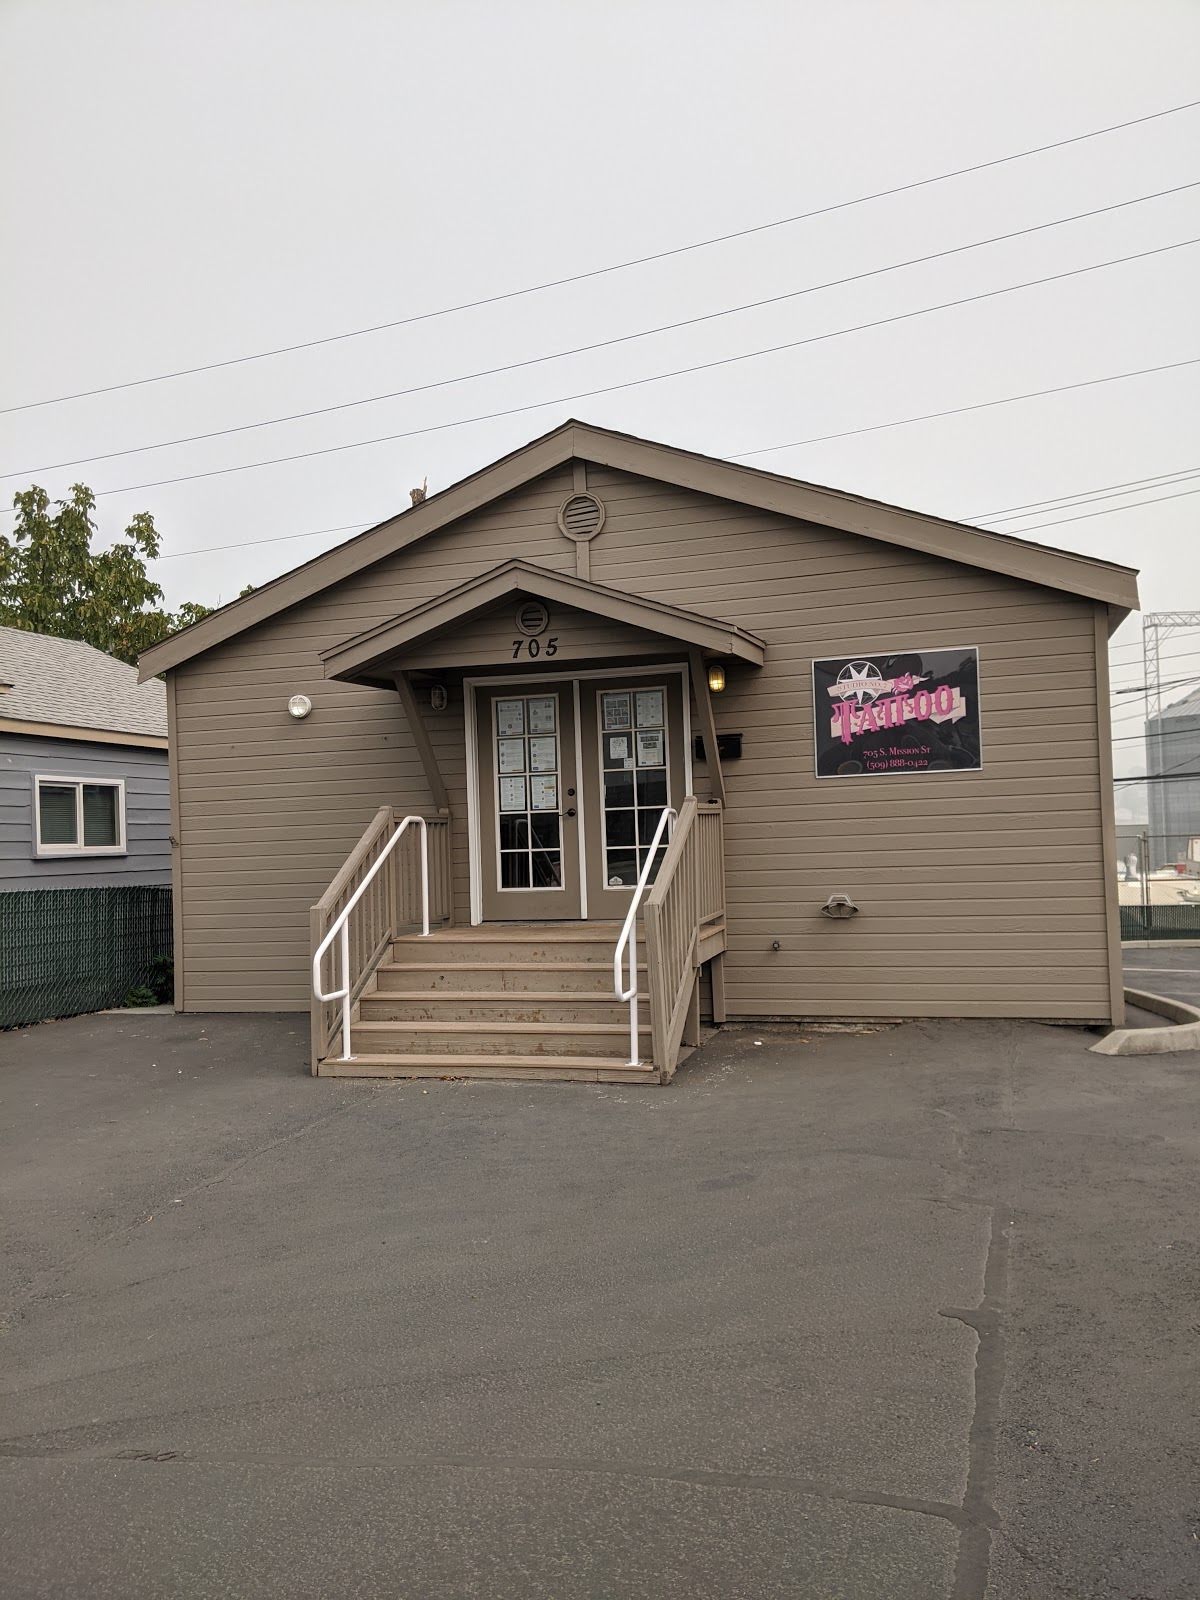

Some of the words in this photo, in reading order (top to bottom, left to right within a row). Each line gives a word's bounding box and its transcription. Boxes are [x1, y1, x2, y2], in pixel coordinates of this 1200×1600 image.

[513, 637, 559, 659] 705
[837, 681, 867, 691] STUDIO
[831, 685, 955, 746] TATTOO
[863, 750, 878, 759] 705
[880, 747, 888, 756] S.
[867, 759, 888, 770] (509)
[889, 758, 928, 768] 888-0422
